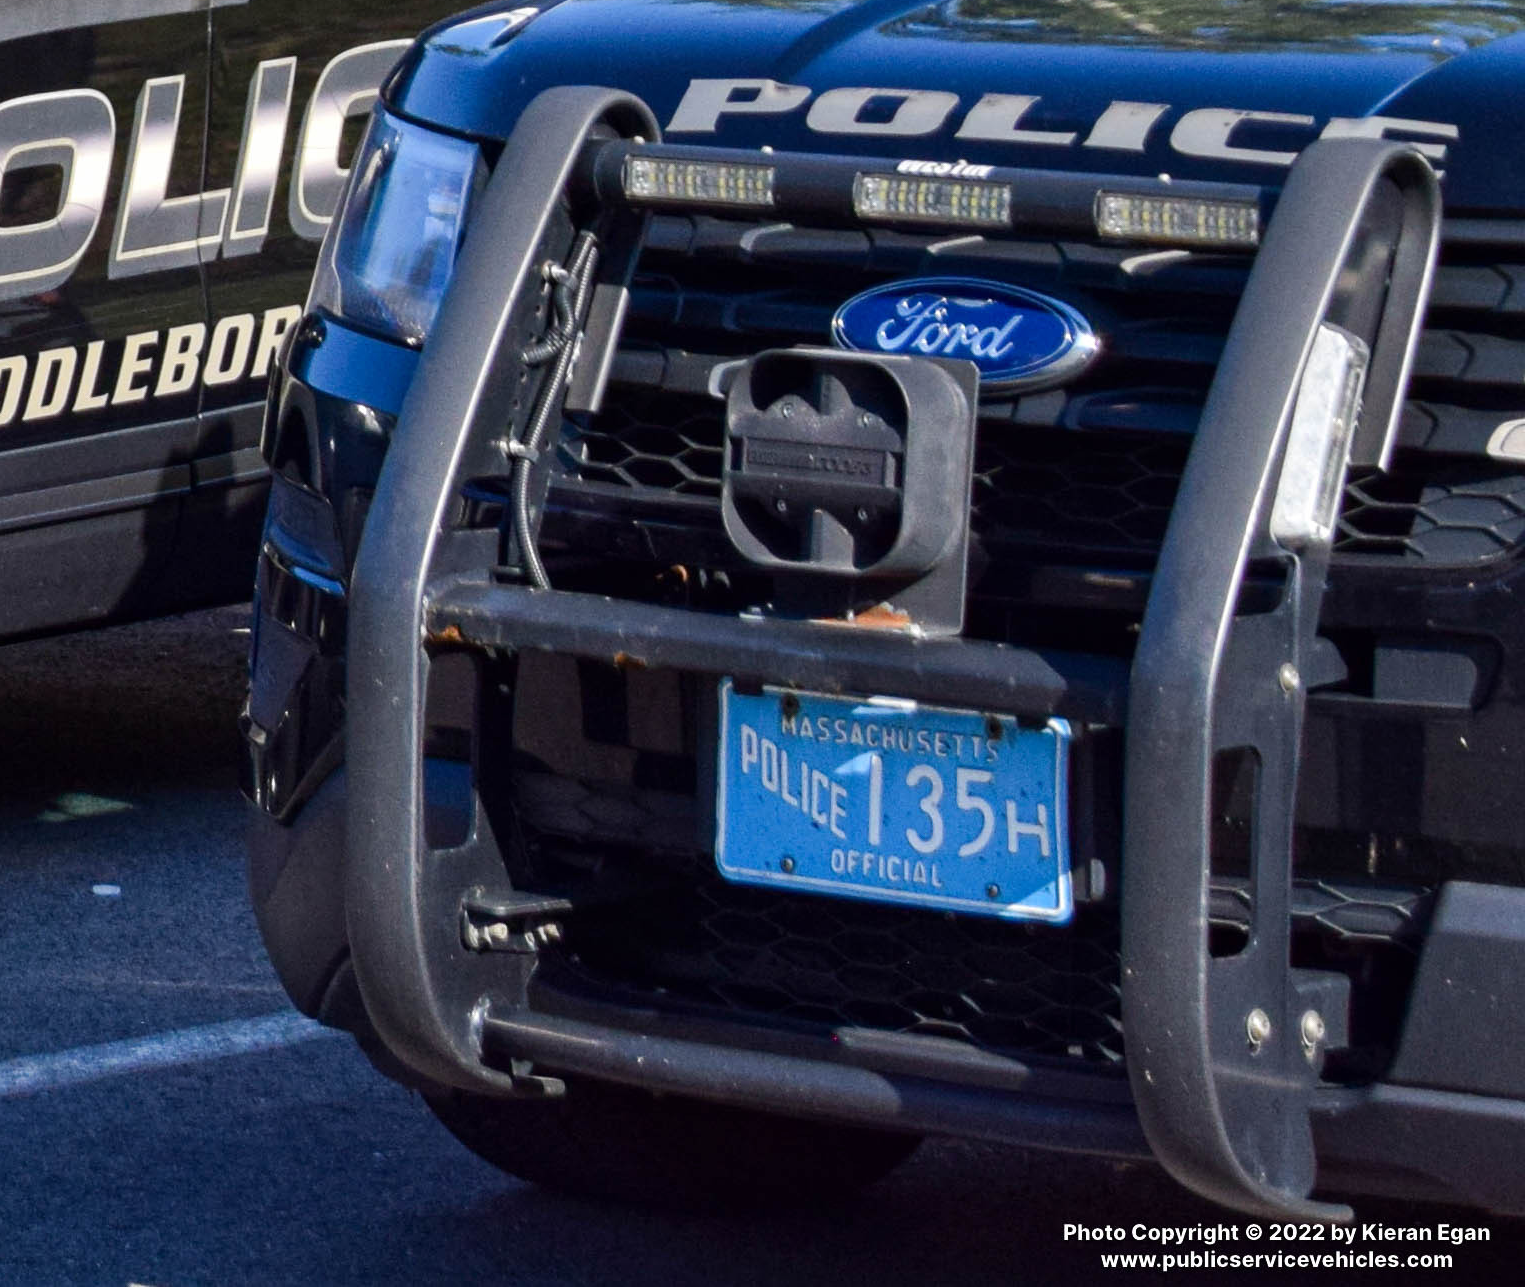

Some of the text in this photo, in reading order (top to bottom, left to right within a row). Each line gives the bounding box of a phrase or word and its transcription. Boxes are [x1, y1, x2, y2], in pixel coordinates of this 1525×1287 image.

[877, 293, 1023, 358] Ford
[782, 714, 999, 762] MASSACHUSETTS
[740, 724, 847, 840] POLICE
[830, 848, 942, 888] OFFICIAL
